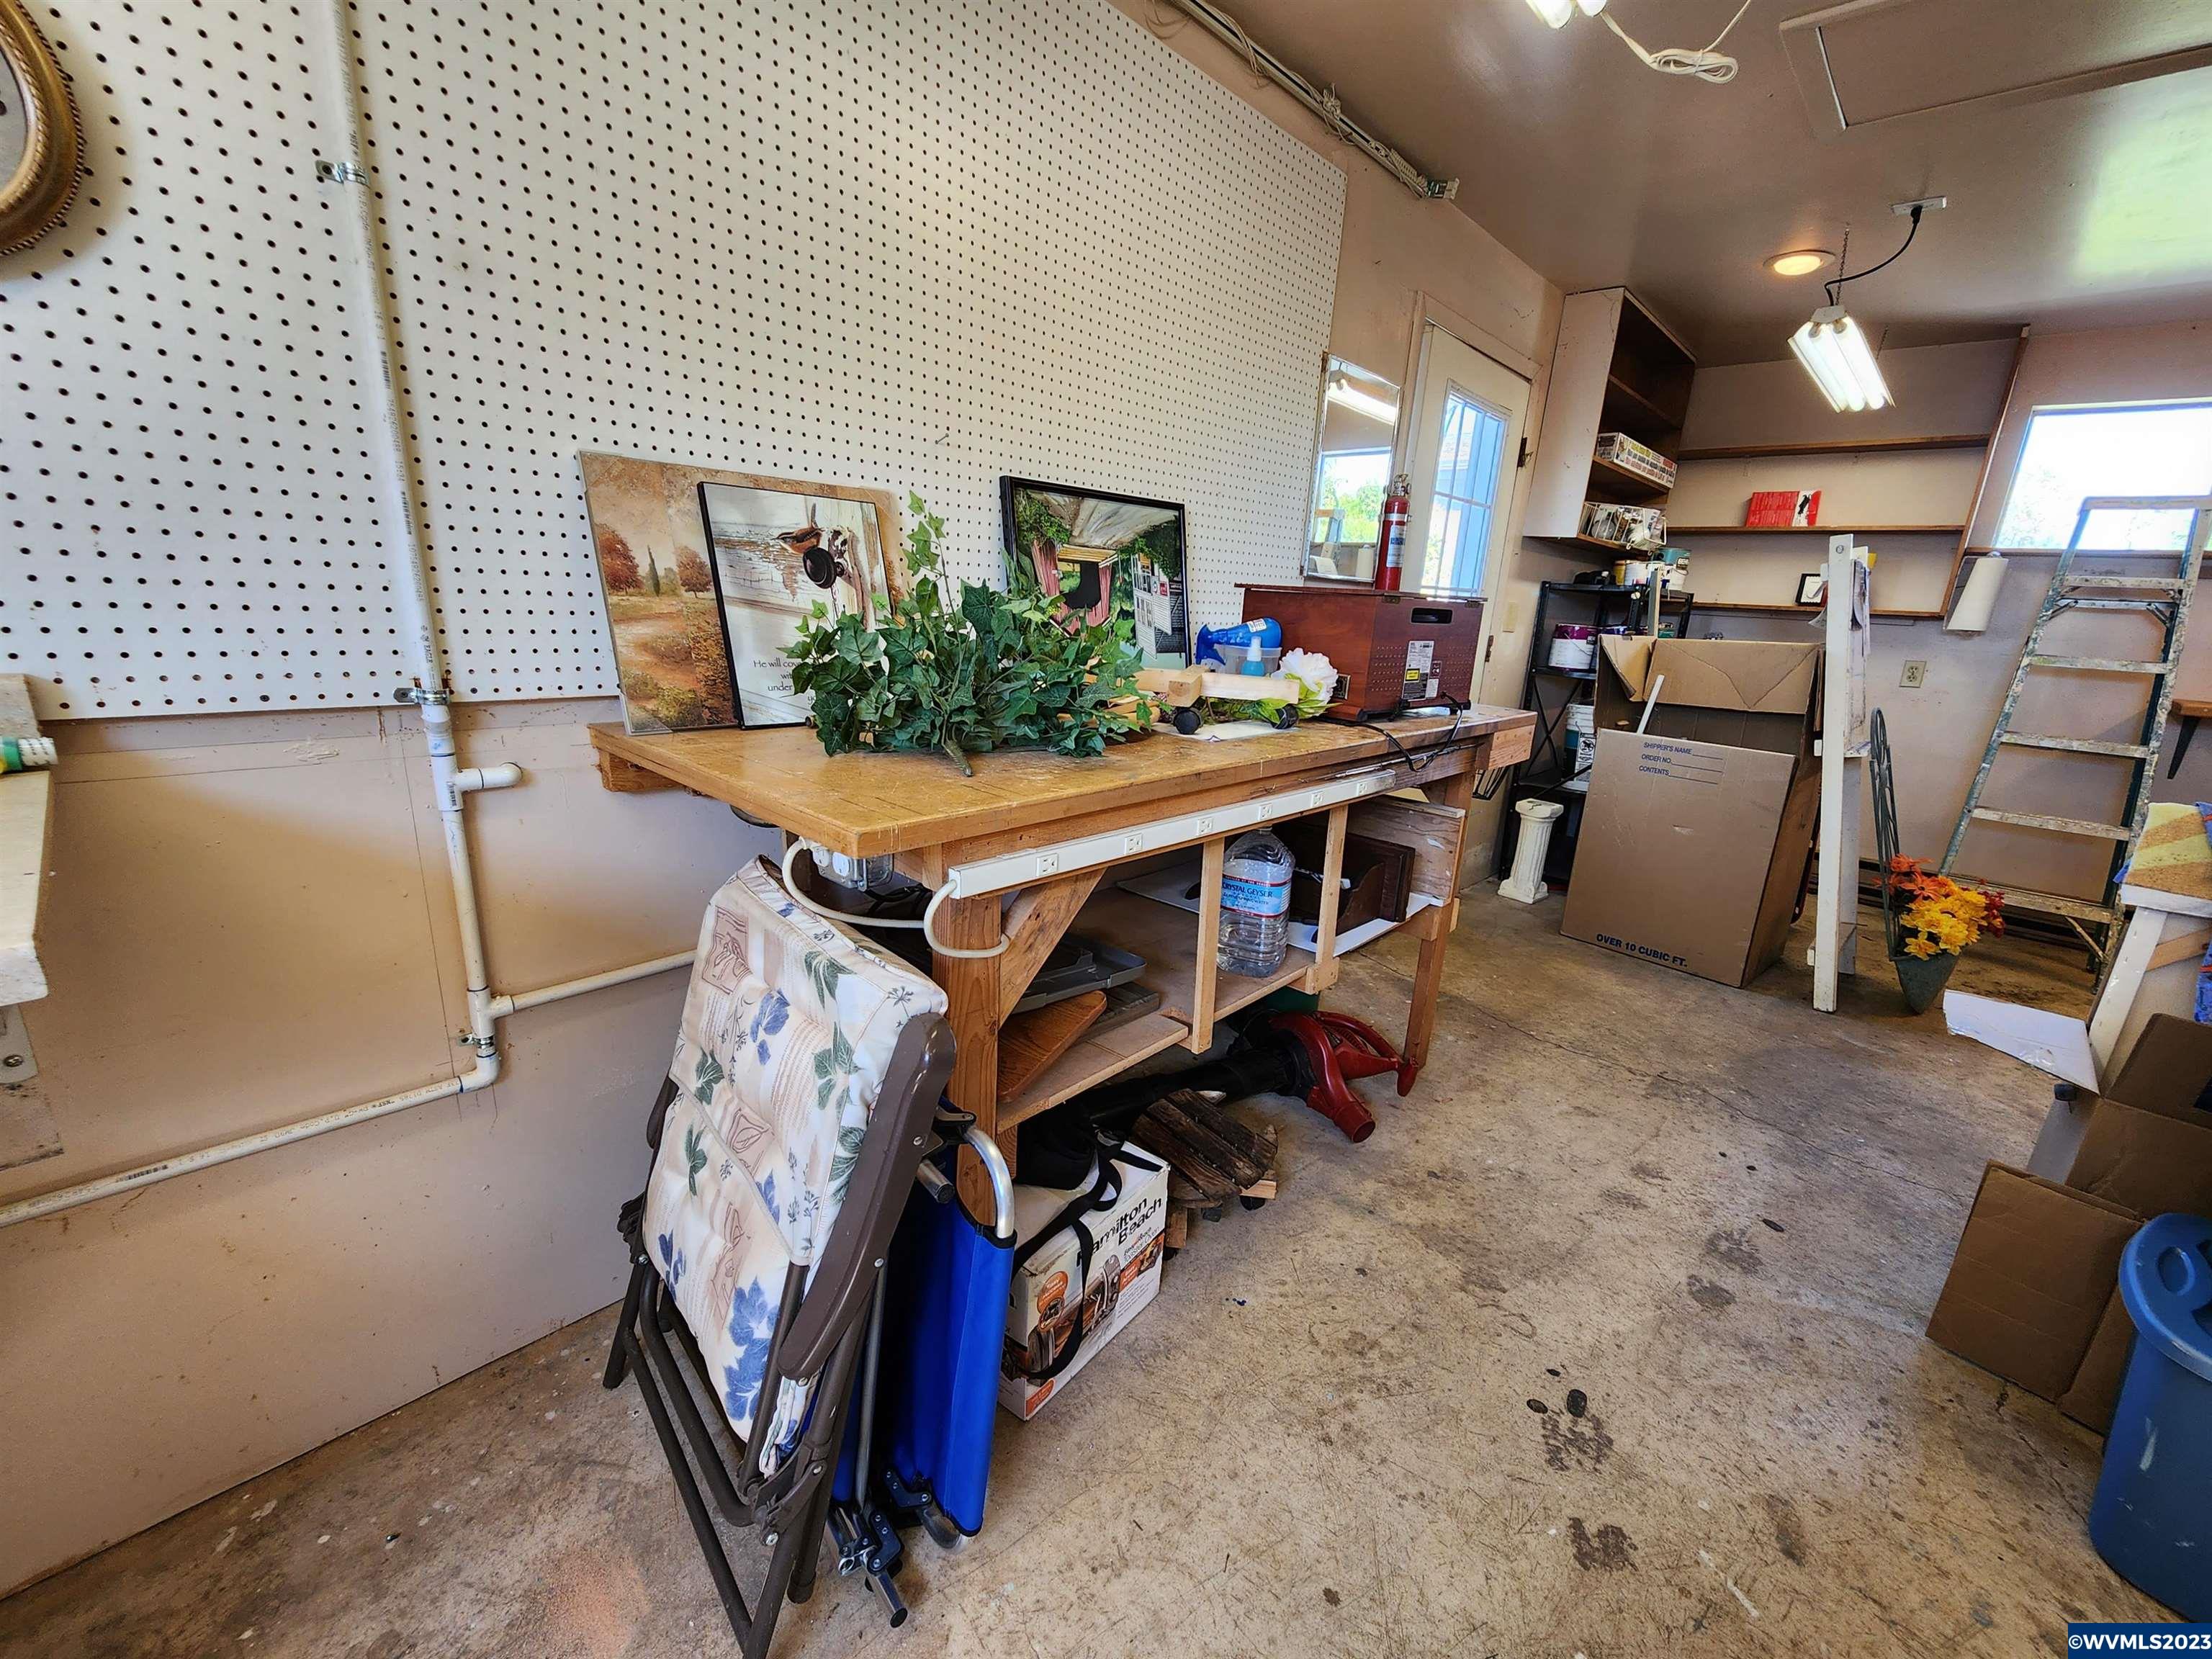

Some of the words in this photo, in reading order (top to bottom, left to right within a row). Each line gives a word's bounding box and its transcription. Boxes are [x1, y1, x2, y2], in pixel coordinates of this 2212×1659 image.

[768, 657, 781, 667] will
[768, 681, 793, 691] under
[1643, 742, 1673, 752] SHIPPER'S
[1641, 753, 1662, 763] ORDER
[1223, 881, 1246, 893] CRYSTAL
[1246, 887, 1273, 898] GEYSER
[1596, 933, 1622, 948] OVER
[1625, 942, 1636, 951] 10
[1638, 946, 1670, 961] CUBIC
[1672, 956, 1687, 966] FT.
[1118, 1197, 1161, 1246] Beach
